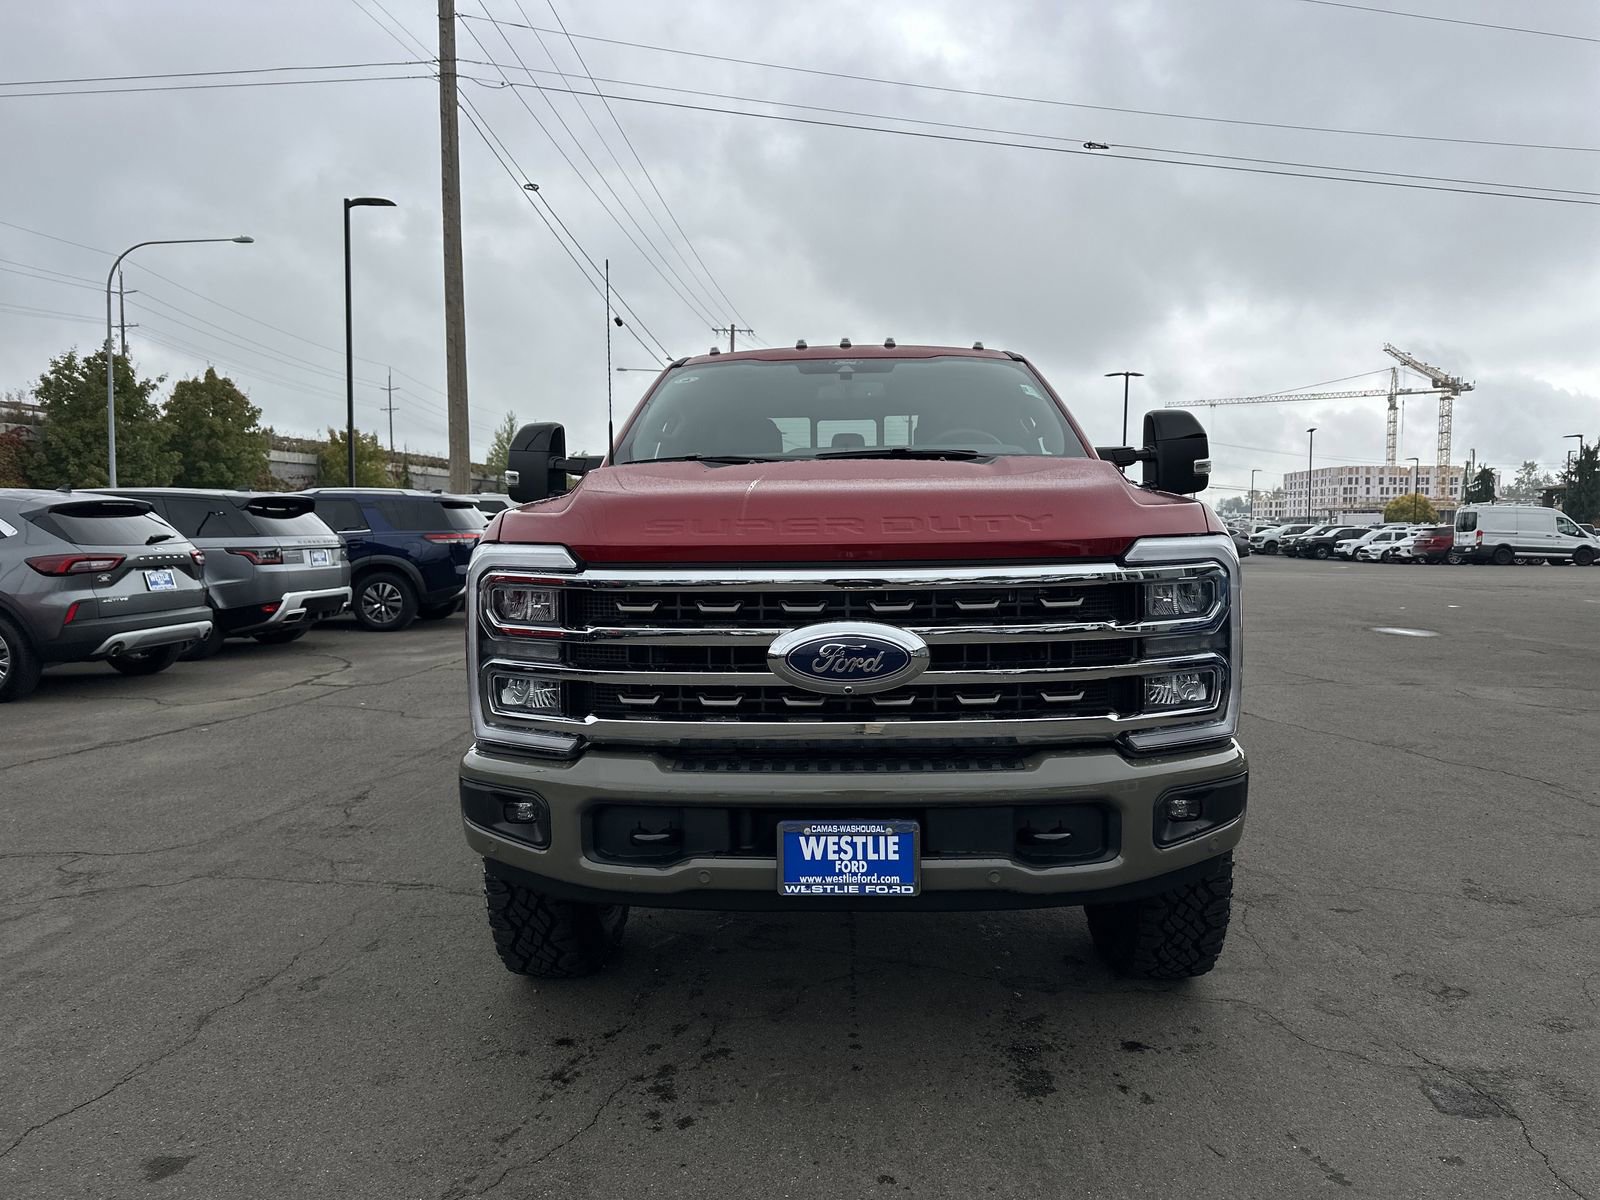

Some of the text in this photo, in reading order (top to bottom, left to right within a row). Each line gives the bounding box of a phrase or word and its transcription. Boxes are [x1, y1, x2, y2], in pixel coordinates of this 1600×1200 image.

[643, 513, 1054, 536] SUPER DUTY
[811, 643, 885, 673] Ford
[811, 825, 885, 833] CAMAS-WASHOUGAL
[799, 835, 900, 861] WESTLIE
[835, 860, 868, 873] FORD
[800, 873, 900, 884] www.westlieford.com
[784, 885, 914, 894] WESTLIE FORD
